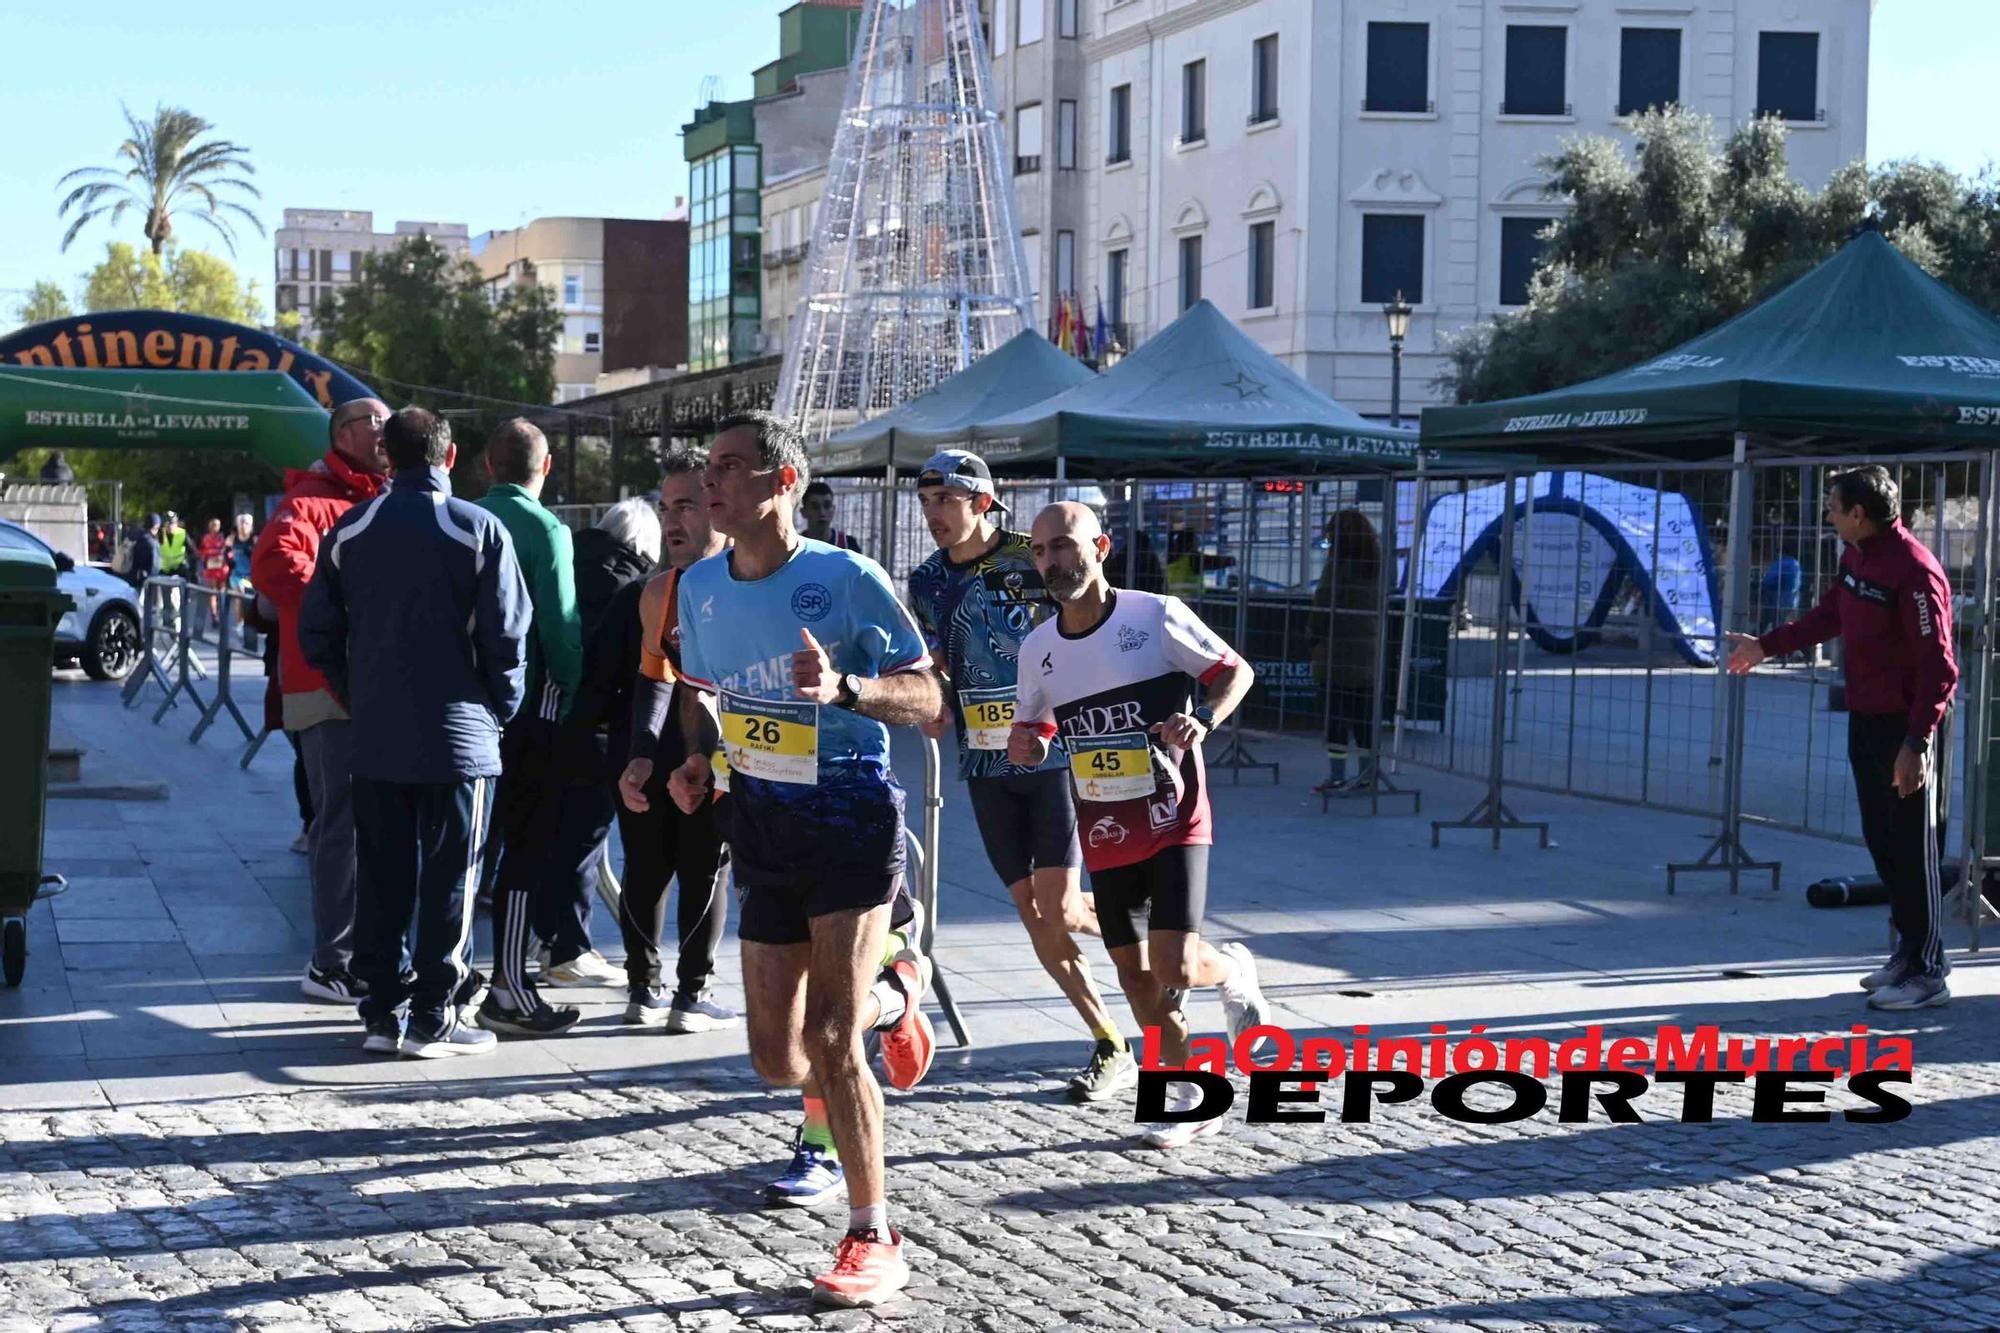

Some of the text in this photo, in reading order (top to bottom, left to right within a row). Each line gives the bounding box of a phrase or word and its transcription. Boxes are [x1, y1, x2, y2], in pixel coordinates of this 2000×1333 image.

[25, 409, 137, 428] ESTRELLA
[153, 413, 249, 430] LEVANTE
[1503, 413, 1572, 432] ESTRELLA
[1577, 408, 1649, 428] LEVANTE
[1205, 431, 1323, 449] ESTRELLA
[1325, 437, 1341, 447] DE
[800, 595, 824, 610] SR
[977, 702, 1015, 722] 185
[1062, 701, 1148, 737] TÁDER
[745, 717, 780, 744] 26
[1091, 751, 1121, 771] 45
